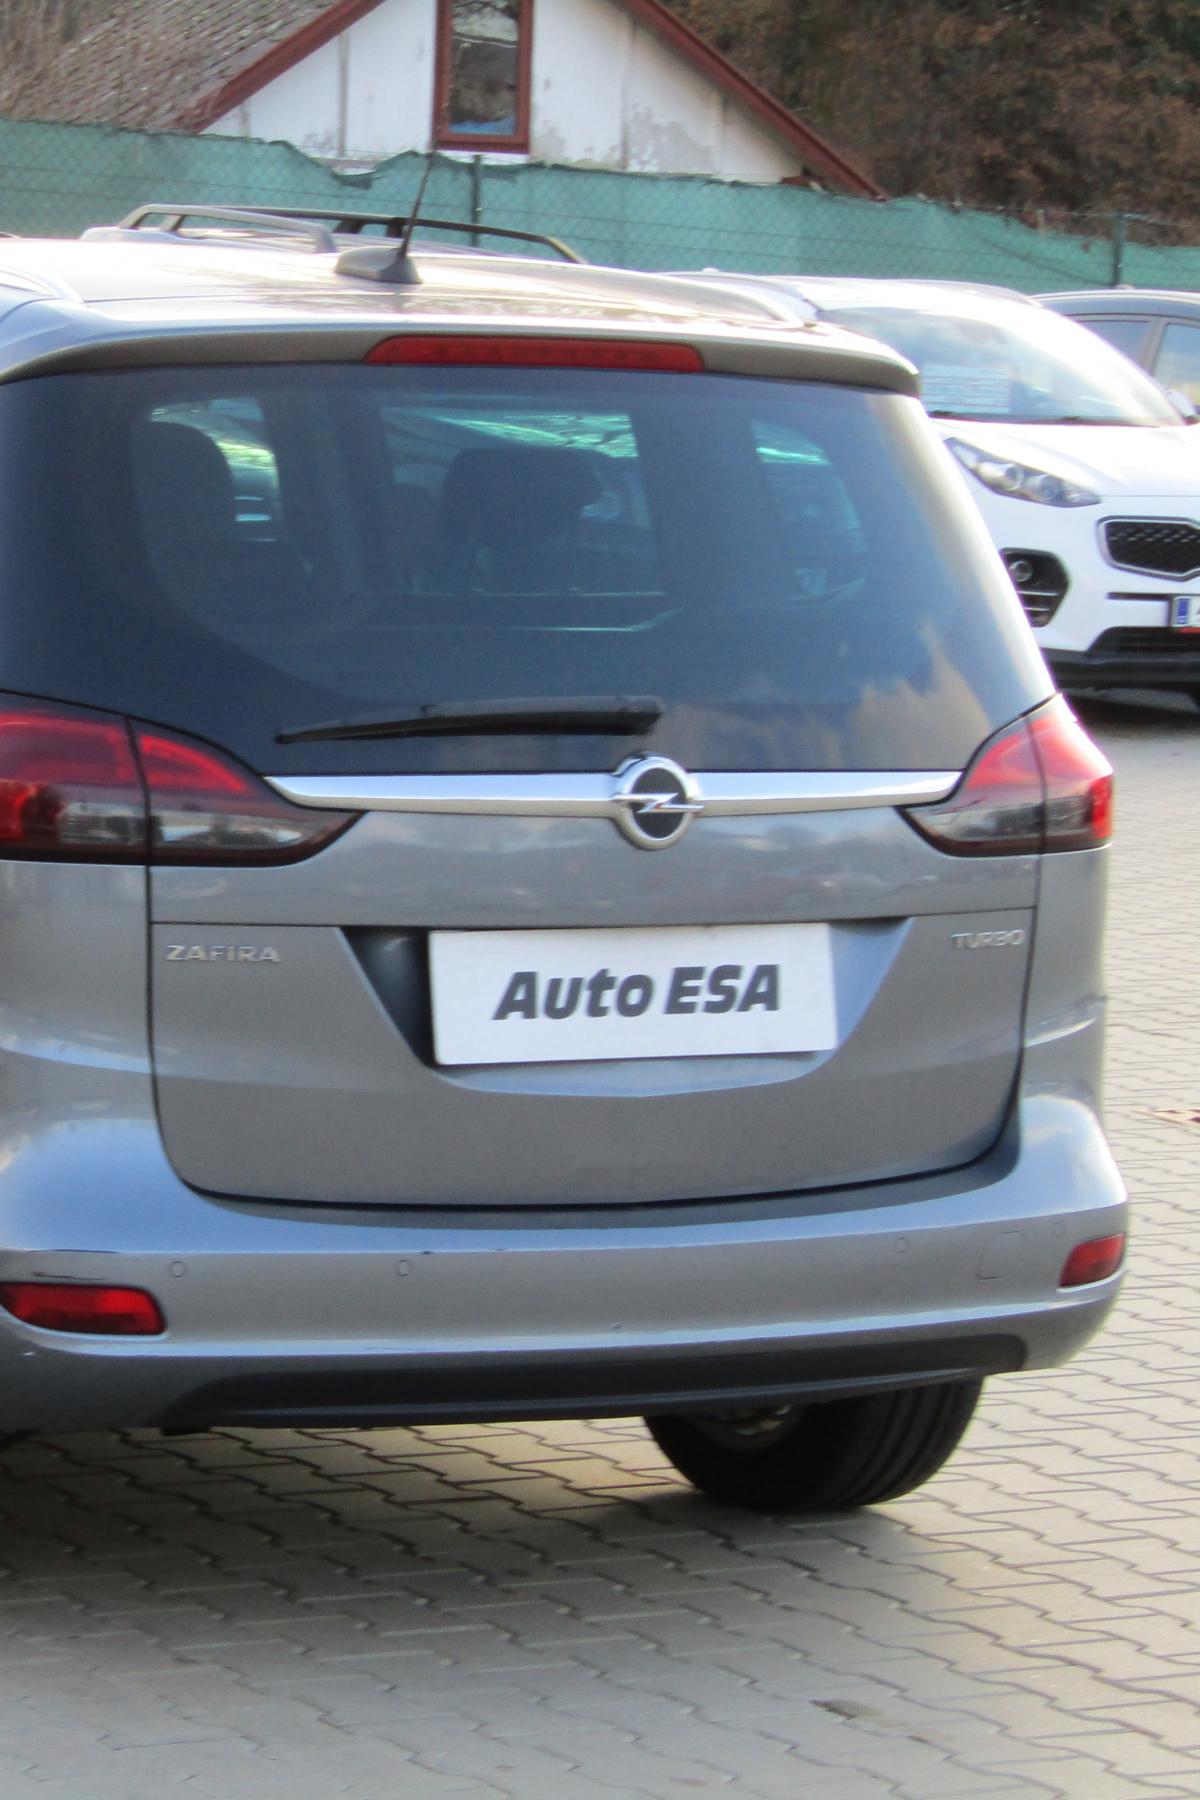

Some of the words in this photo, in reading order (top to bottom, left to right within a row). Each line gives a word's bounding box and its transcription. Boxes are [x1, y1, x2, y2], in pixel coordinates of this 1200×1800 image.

[951, 929, 1025, 949] TURBO
[166, 944, 281, 963] ZAFIRA
[492, 968, 654, 1021] Auto
[663, 964, 780, 1015] ESA
